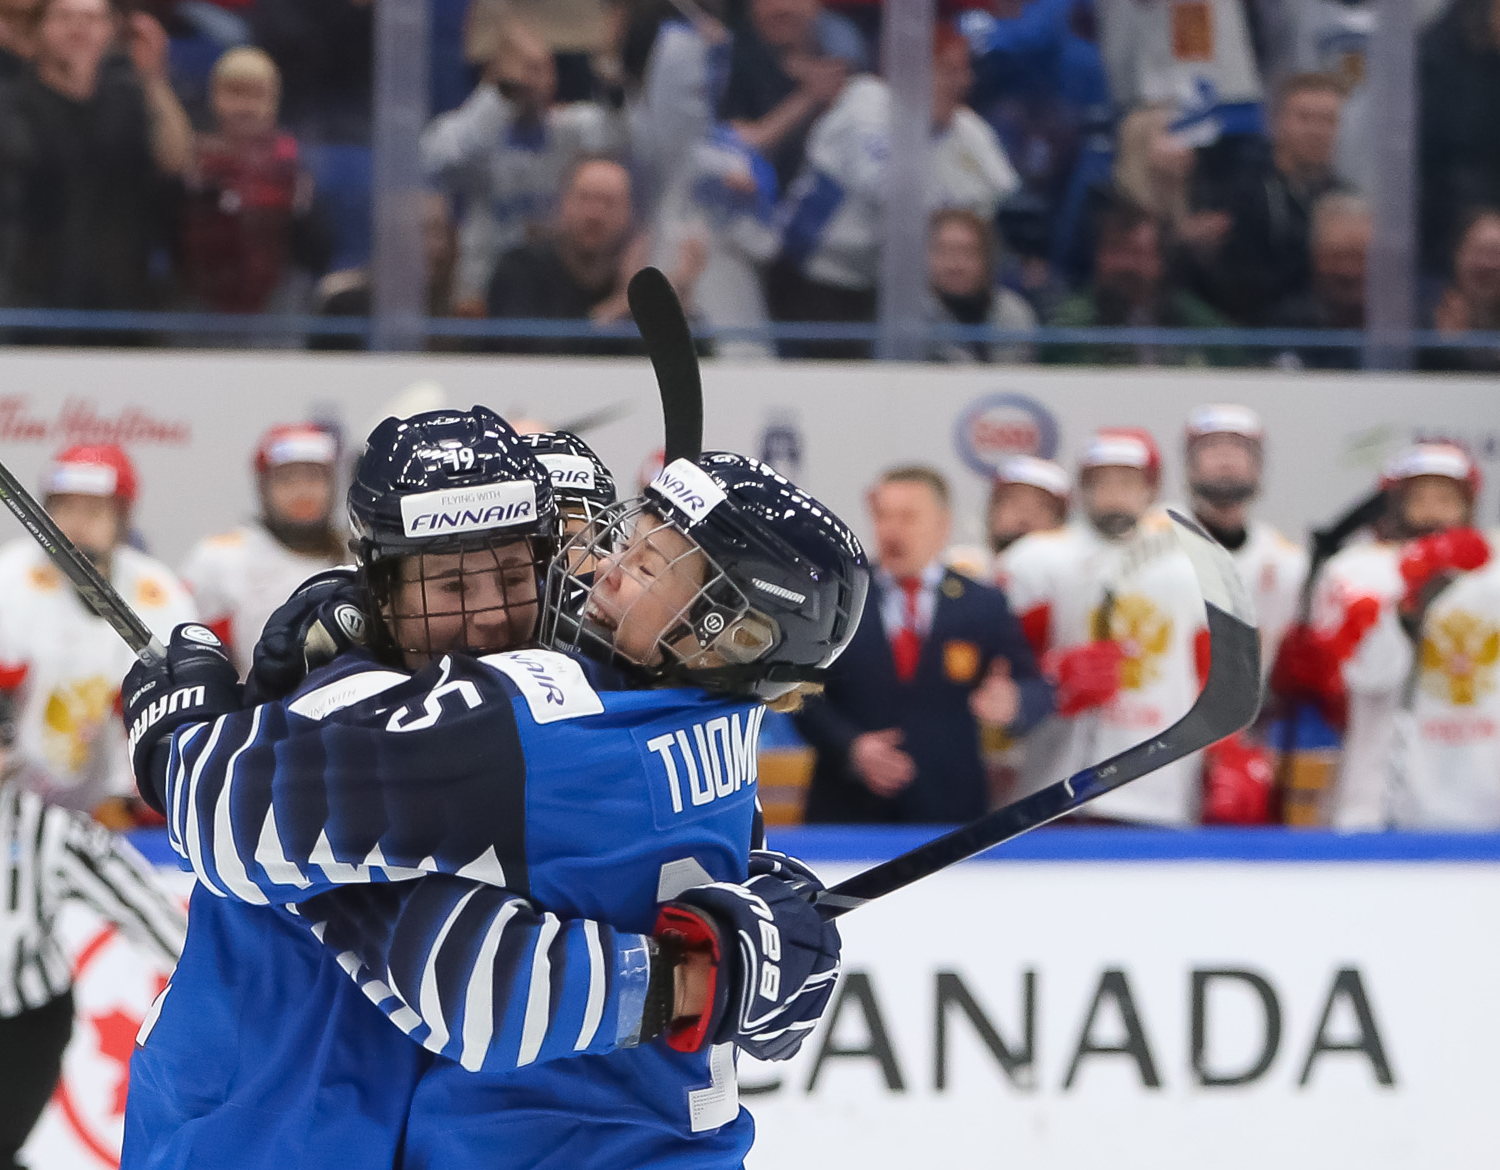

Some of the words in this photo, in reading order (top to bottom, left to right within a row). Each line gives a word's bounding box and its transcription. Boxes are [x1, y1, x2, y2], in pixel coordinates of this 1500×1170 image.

[410, 500, 532, 532] FINNAIR
[442, 493, 476, 506] FLYING
[477, 490, 501, 503] WITH
[722, 882, 784, 1002] BAU
[736, 966, 1396, 1096] ANADA
